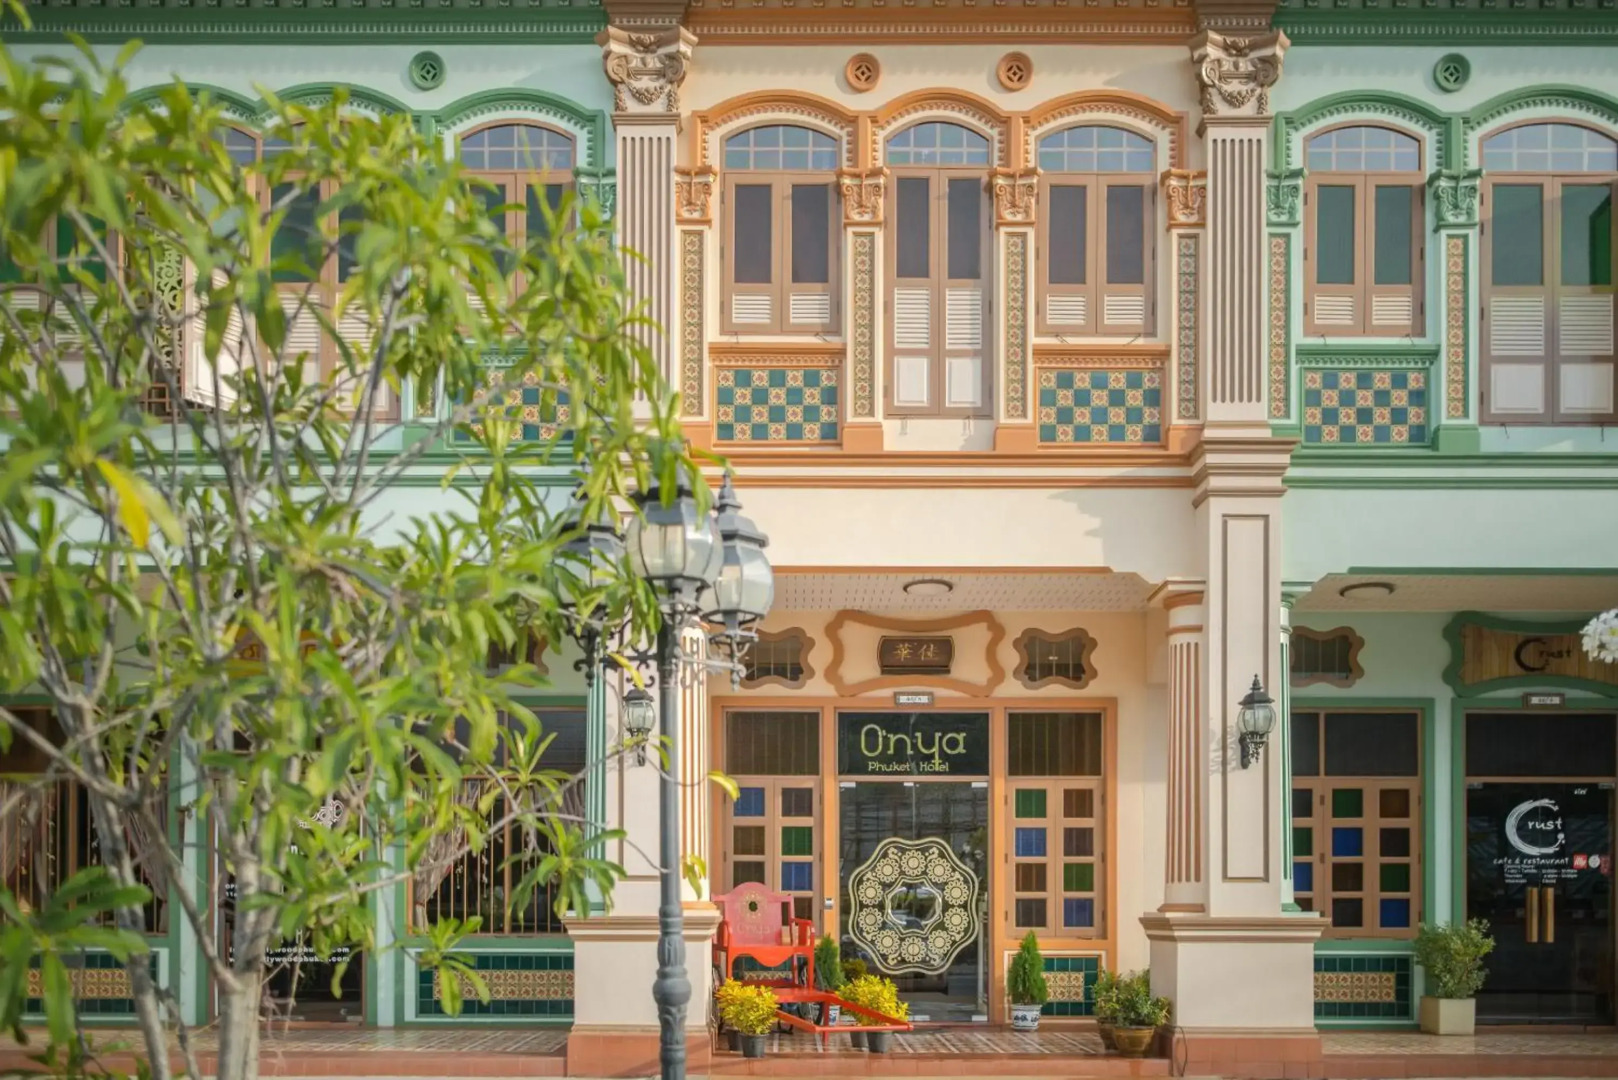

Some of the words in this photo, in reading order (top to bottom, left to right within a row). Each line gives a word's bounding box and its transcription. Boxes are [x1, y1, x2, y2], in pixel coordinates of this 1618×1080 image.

[1514, 637, 1571, 673] Crust
[868, 761, 911, 772] Phuket
[919, 761, 949, 772] Hotel
[1505, 798, 1566, 856] Crust
[1523, 857, 1569, 865] restaurant
